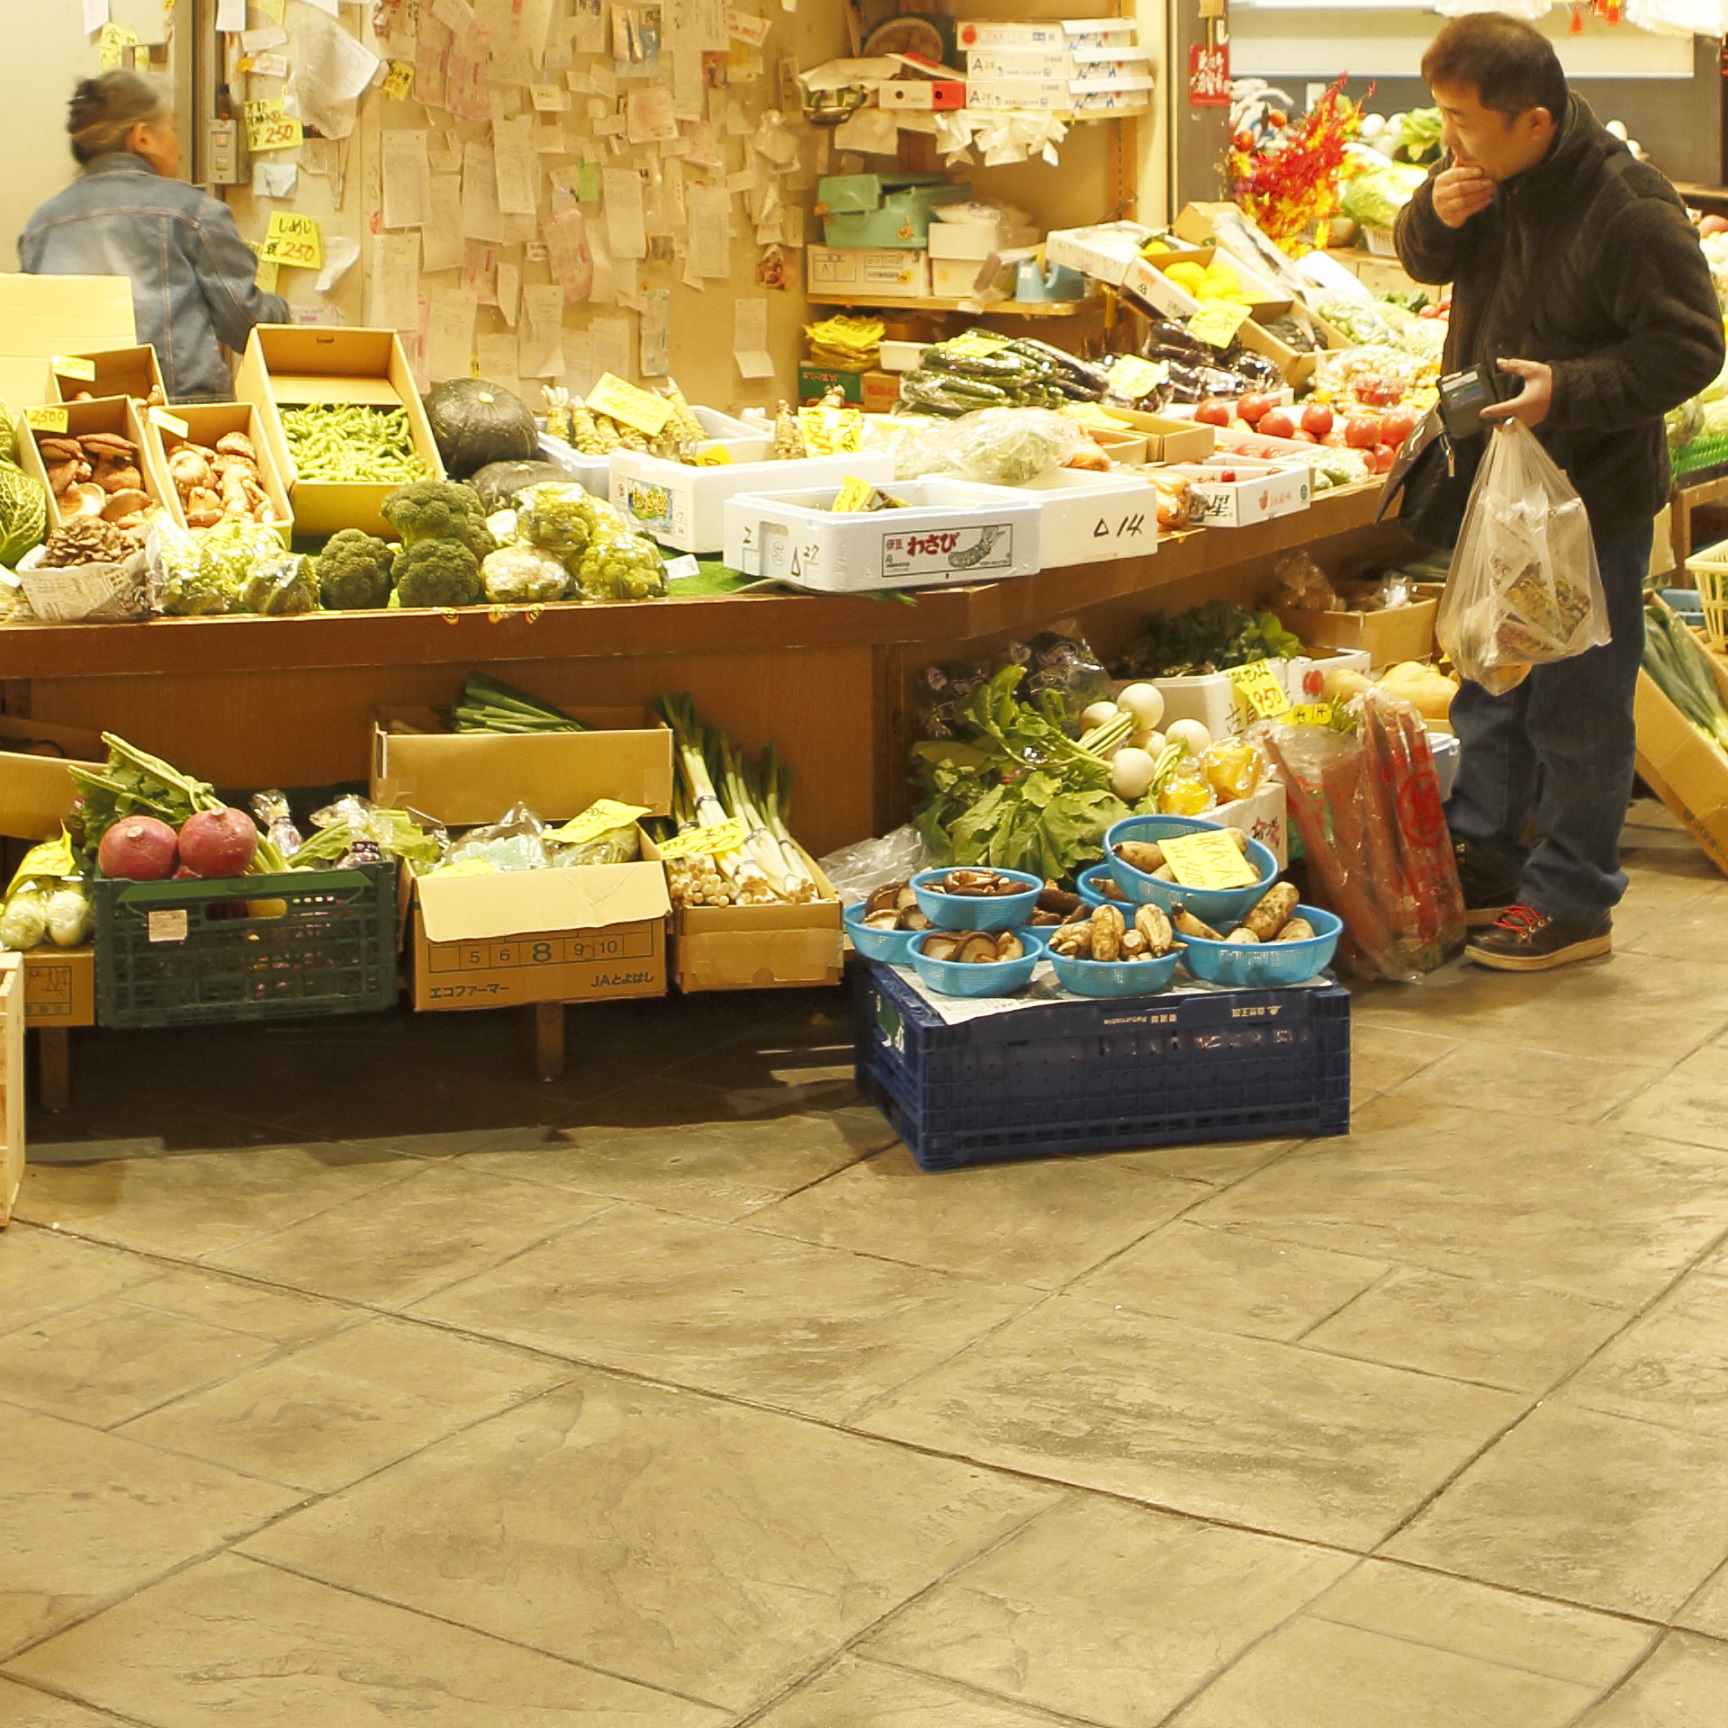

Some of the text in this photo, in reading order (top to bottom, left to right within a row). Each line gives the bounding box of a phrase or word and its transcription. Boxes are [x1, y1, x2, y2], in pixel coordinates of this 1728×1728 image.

[278, 216, 311, 234] しめじ
[281, 243, 315, 262] 250
[1116, 512, 1146, 537] 14
[906, 530, 962, 557] わさび
[469, 941, 618, 964] 5 6 8 9 10
[591, 972, 654, 988] JAとよはし
[430, 983, 509, 999] エコファーマー
